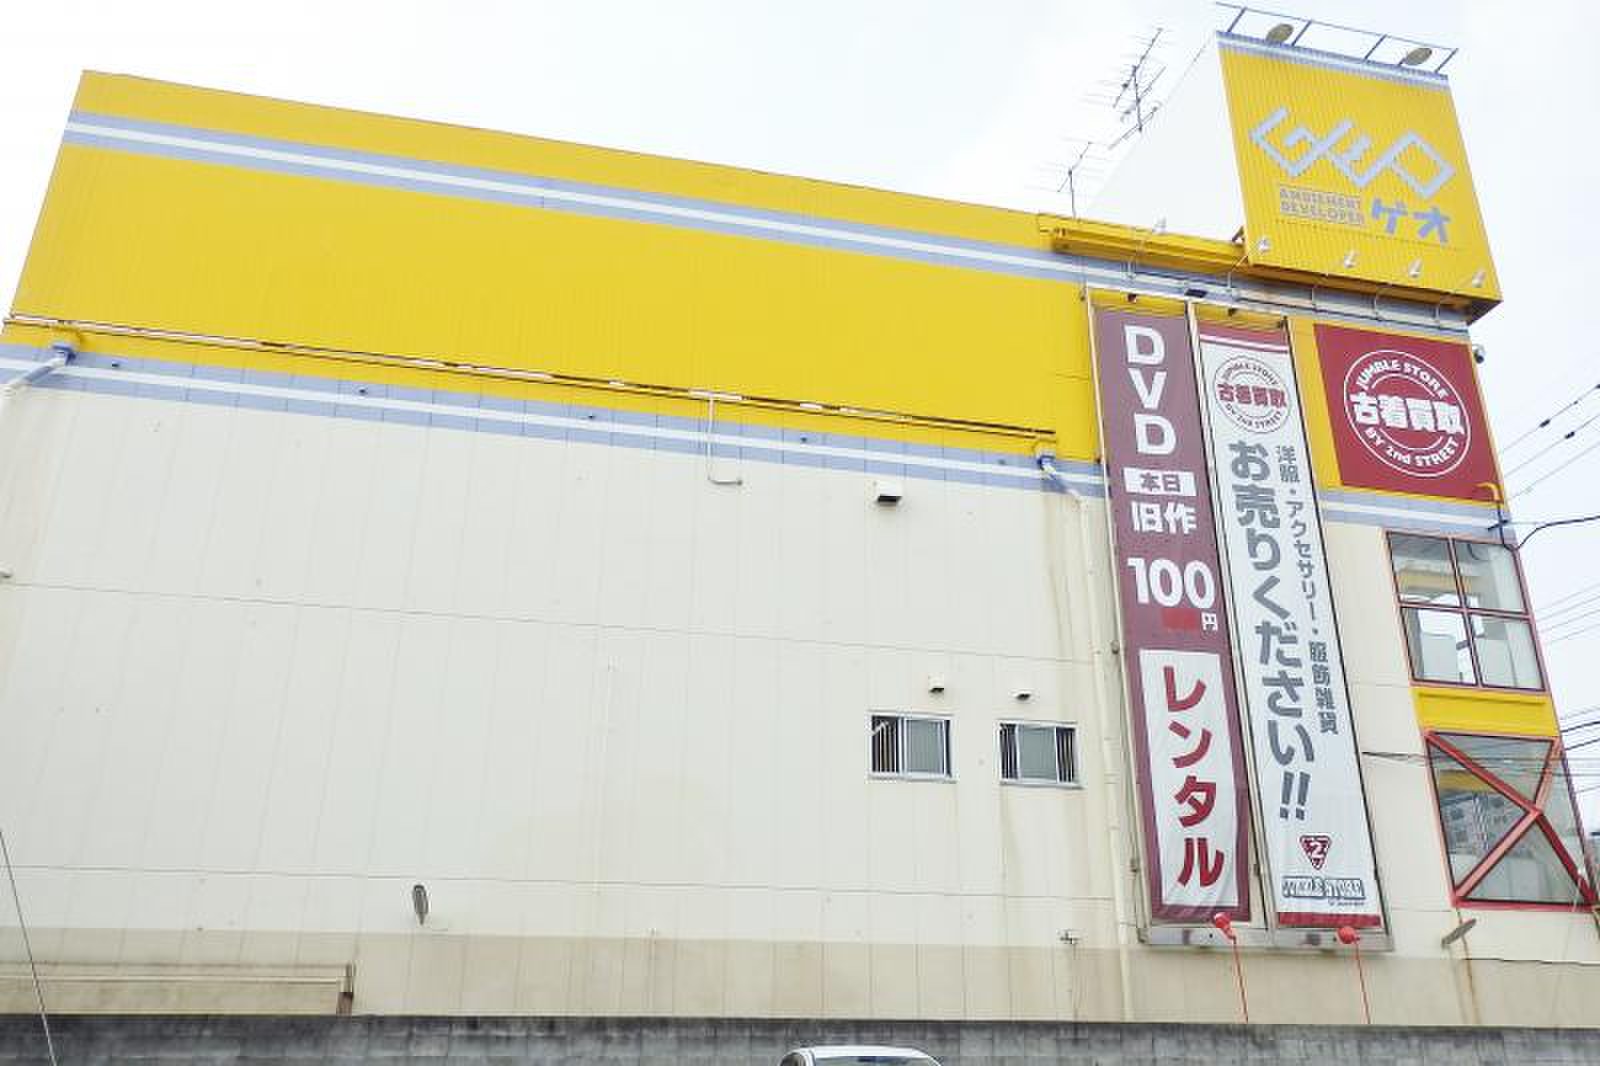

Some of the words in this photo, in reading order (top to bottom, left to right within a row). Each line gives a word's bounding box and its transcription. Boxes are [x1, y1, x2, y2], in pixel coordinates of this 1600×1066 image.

[1371, 197, 1450, 243] ゲオ
[1123, 325, 1177, 455] DVD
[1217, 382, 1287, 408] 古着買取
[1356, 359, 1400, 391] JUMBLE
[1403, 362, 1449, 399] STORE
[1350, 391, 1465, 435] 古着買取
[1364, 427, 1385, 446] BY
[1386, 444, 1411, 465] 2nd
[1414, 437, 1459, 467] STREET
[1139, 473, 1182, 493] 本日
[1131, 501, 1197, 535] 旧作
[1163, 665, 1225, 887] レンタル
